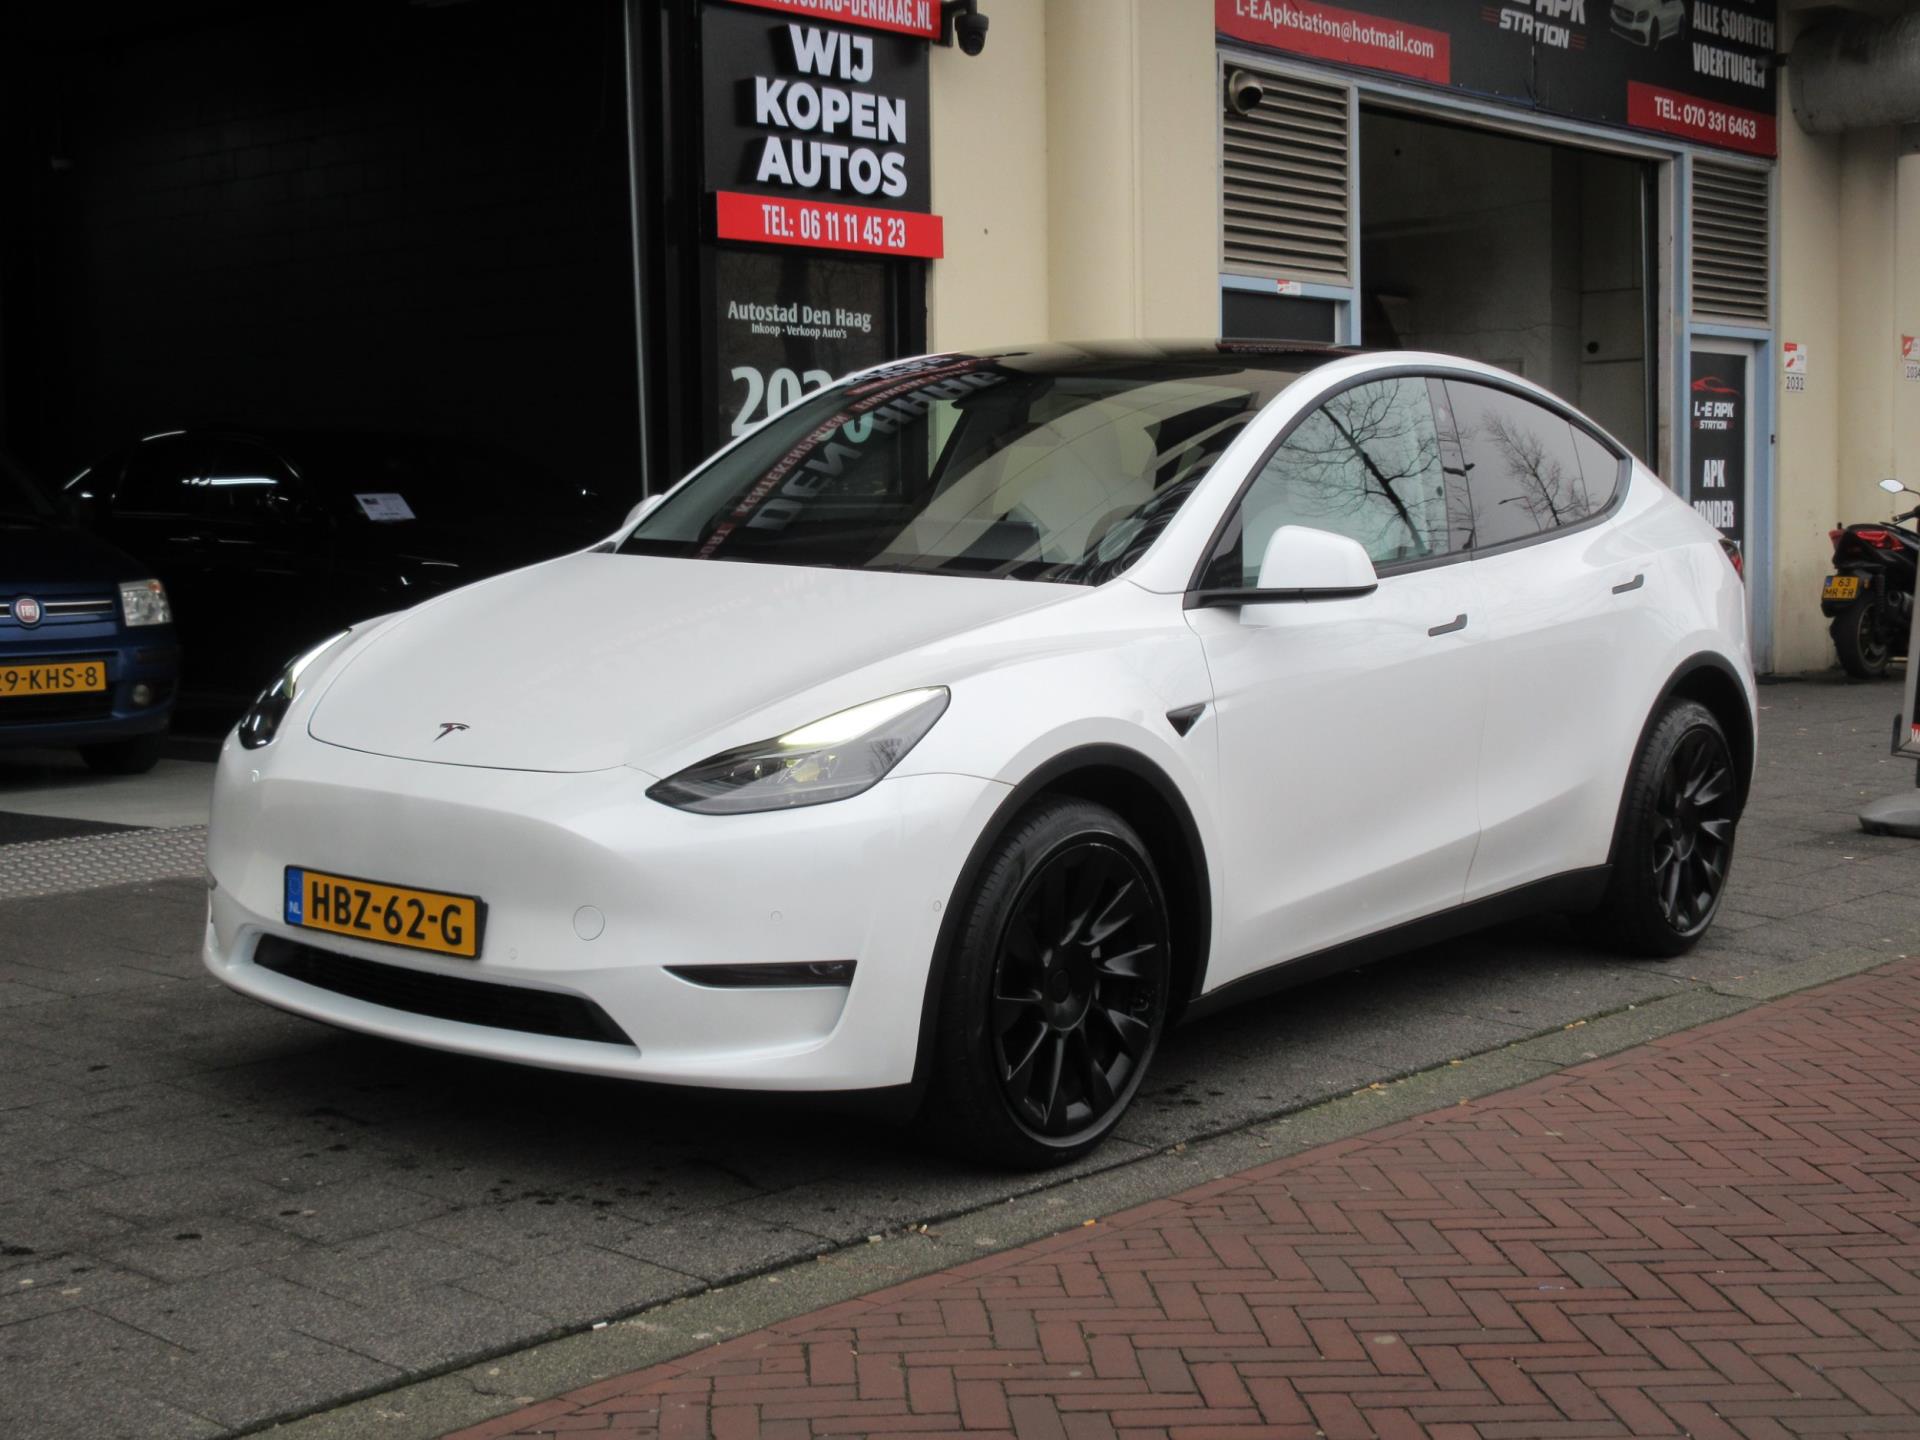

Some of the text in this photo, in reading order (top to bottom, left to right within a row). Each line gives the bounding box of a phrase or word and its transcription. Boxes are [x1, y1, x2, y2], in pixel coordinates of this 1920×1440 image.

[1499, 8, 1570, 49] STATION
[1692, 0, 1775, 50] ALLE SOORTEN
[789, 23, 874, 83] WIJ
[755, 76, 907, 144] KOPEN
[1654, 96, 1757, 140] TEL: 070 331 6463
[756, 136, 908, 198] AUTOS
[762, 204, 906, 249] TEL: 06 11 11 45 23
[728, 300, 872, 333] Autostad Den Haag
[751, 323, 848, 340] Inkoop Verkoop Auto's
[1694, 401, 1735, 418] L-E APK
[1699, 420, 1728, 431] STATION
[1702, 459, 1726, 488] APK
[0, 666, 97, 692] 9-KHS-8
[289, 900, 301, 915] NL
[311, 881, 462, 946] HBZ-62-G
